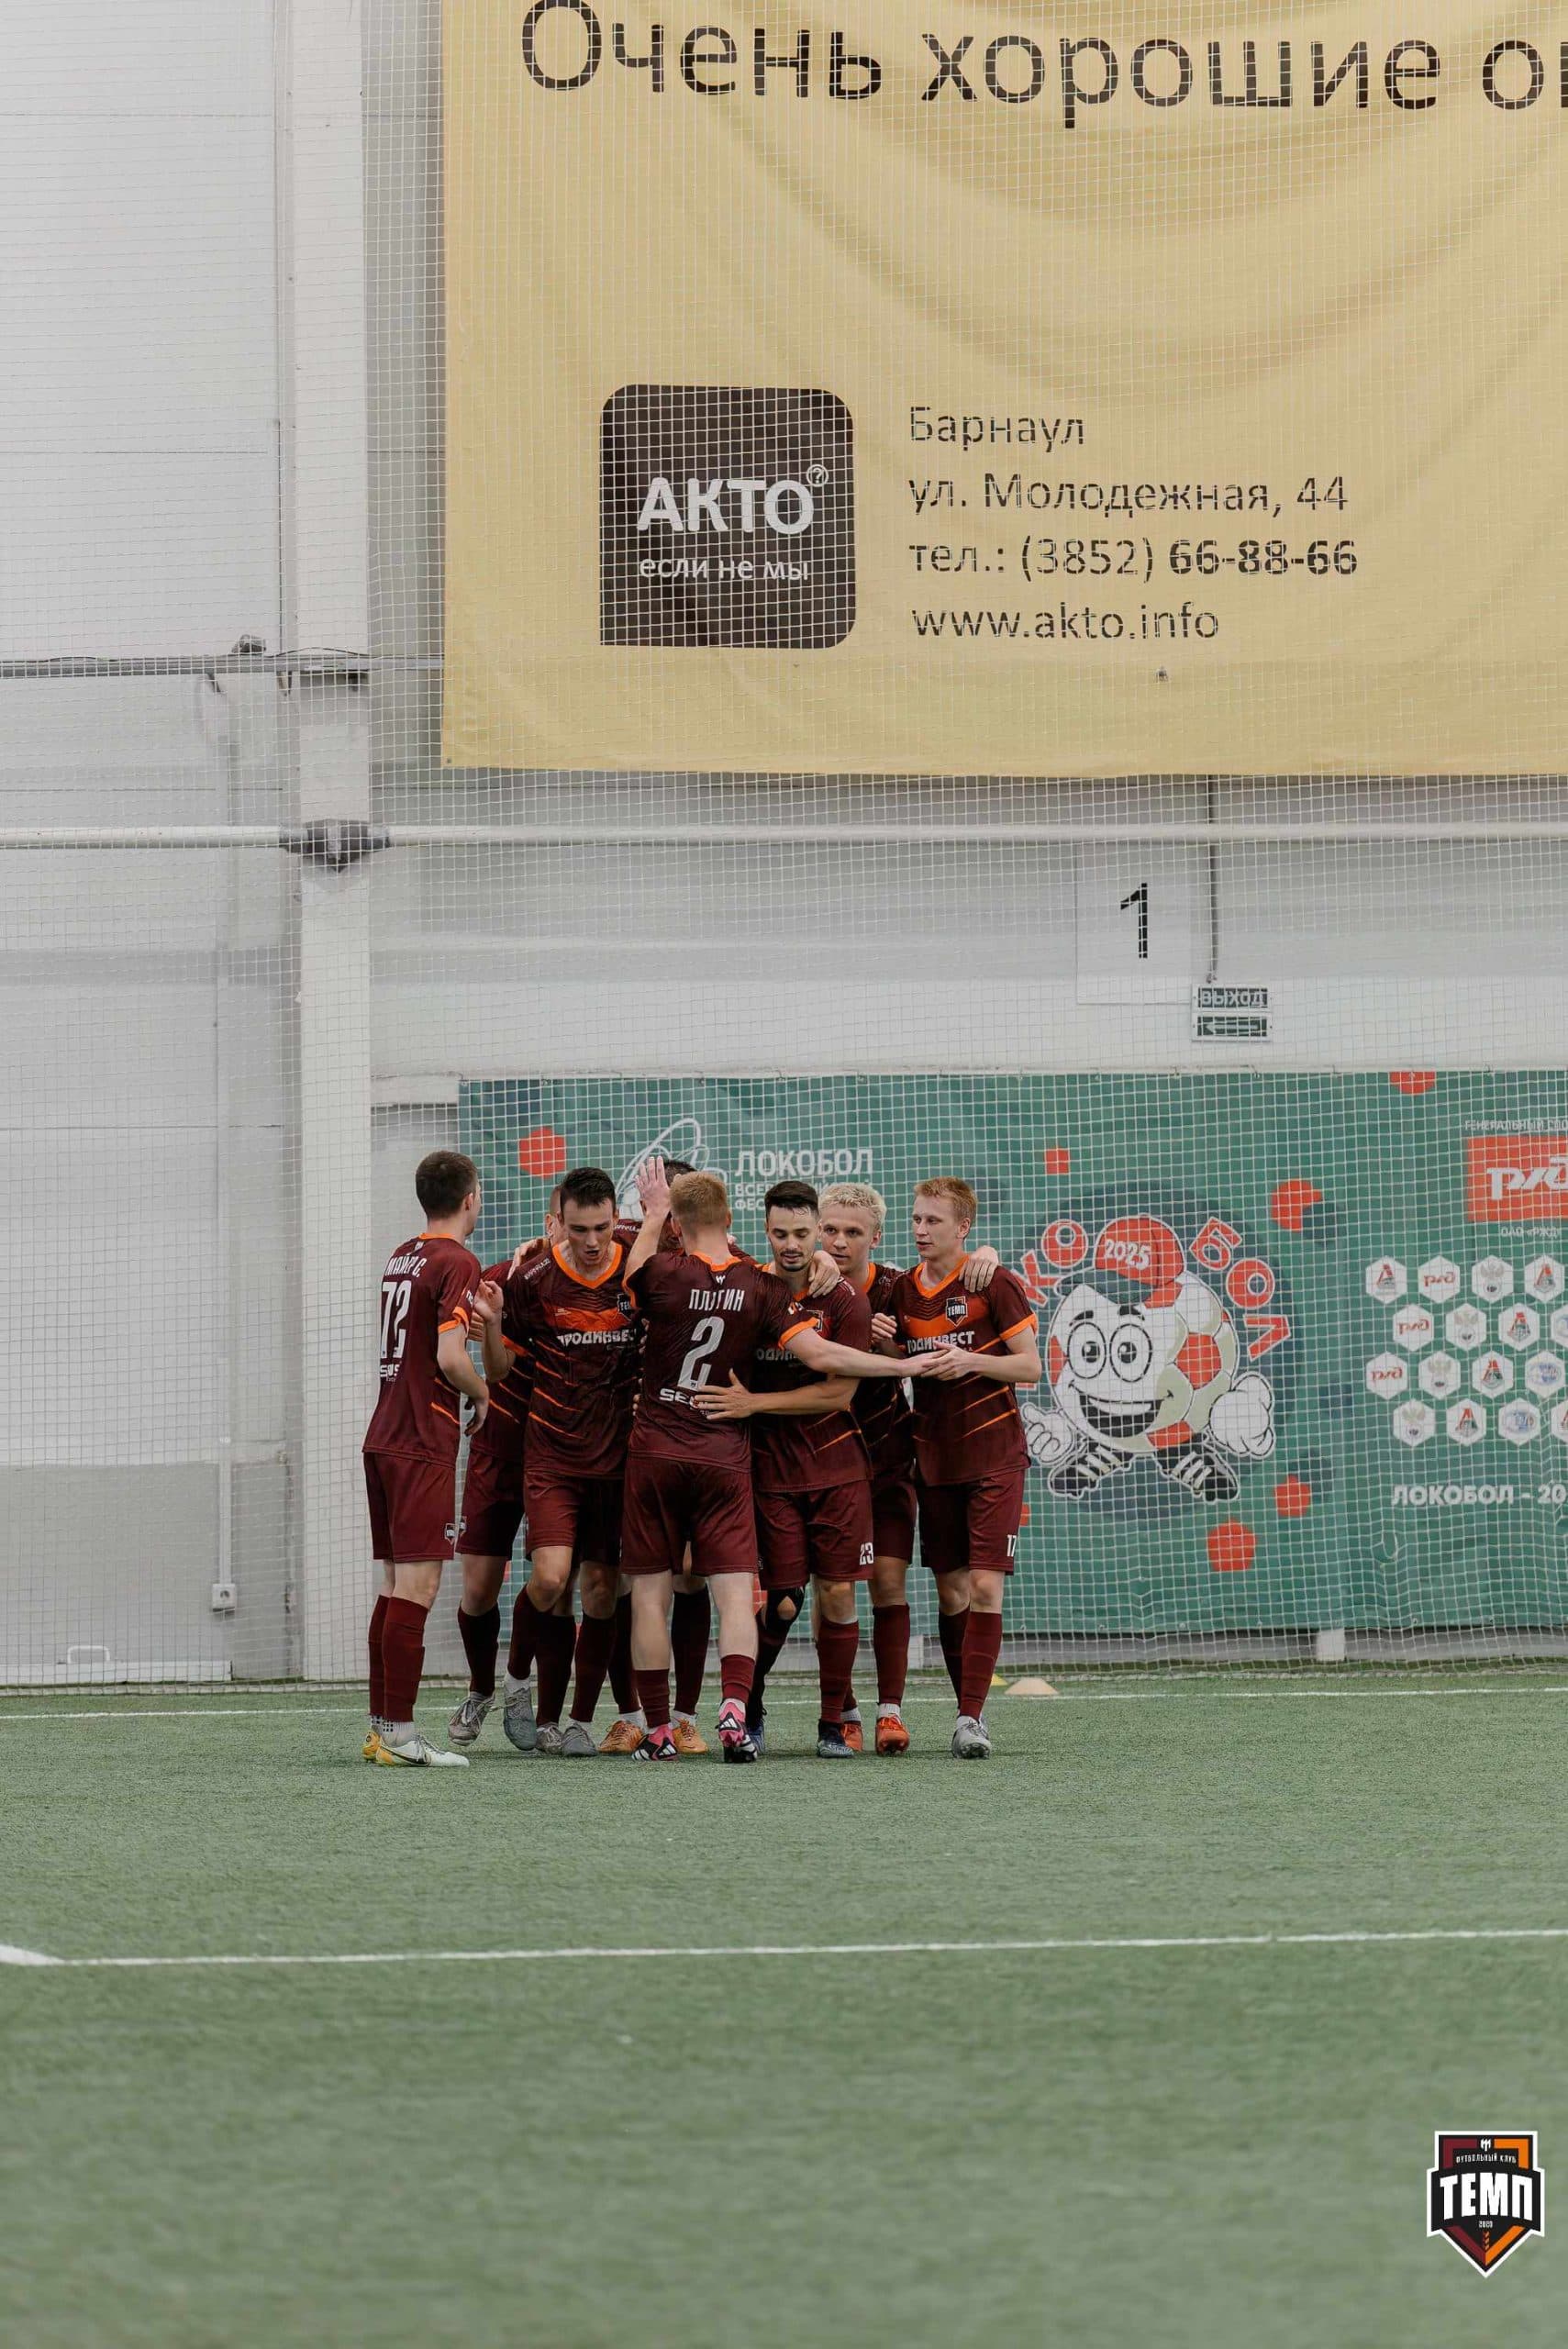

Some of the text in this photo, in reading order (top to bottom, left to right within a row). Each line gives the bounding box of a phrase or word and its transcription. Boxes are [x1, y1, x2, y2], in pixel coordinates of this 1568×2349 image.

[522, 0, 1568, 129] Очень хорошие о
[910, 406, 1084, 453] Барнаул
[637, 476, 815, 535] АКТО
[908, 473, 1349, 518] ул. Молодежная, 44
[639, 558, 808, 581] если не мы
[908, 535, 1358, 584] тел.: (3852) 66-88-66
[912, 601, 1218, 639] www.akto.info
[1120, 882, 1149, 959] 1
[1201, 990, 1264, 1008] ВЫХОД
[735, 1149, 873, 1177] ЛОКОБОЛ
[1104, 1239, 1151, 1271] 2025
[381, 1279, 412, 1359] 72
[948, 1305, 966, 1318] ТЕМП
[677, 1316, 726, 1392] 2
[1392, 1483, 1515, 1506] ЛОКОБОЛ
[859, 1542, 874, 1566] 23
